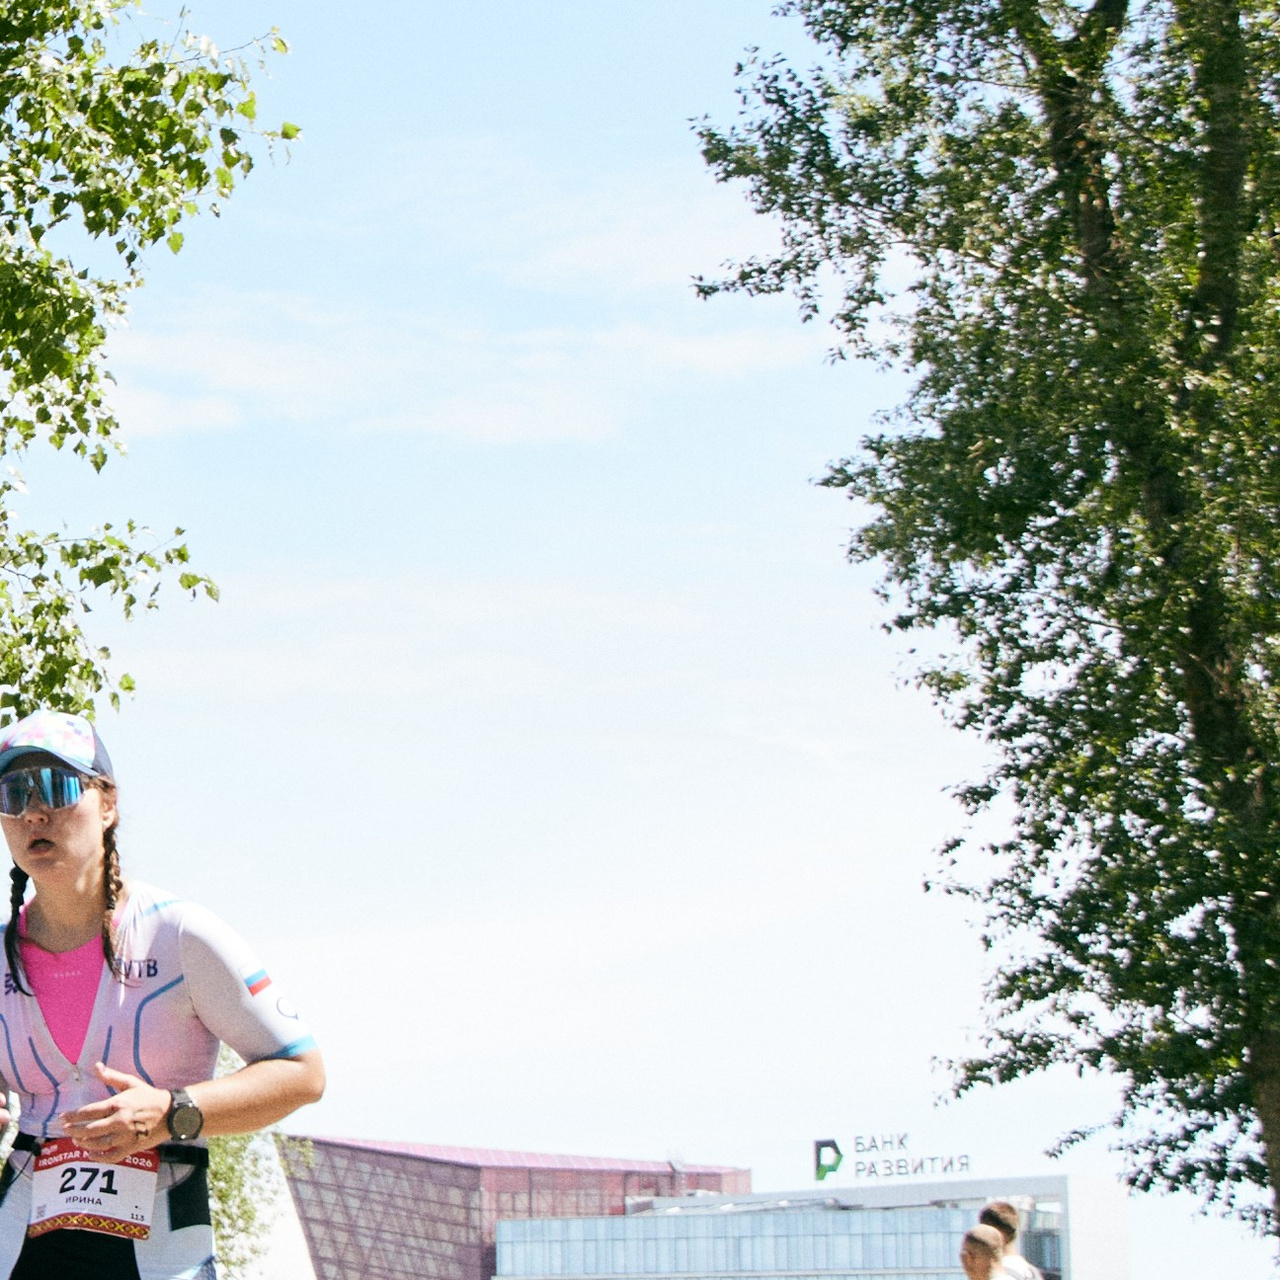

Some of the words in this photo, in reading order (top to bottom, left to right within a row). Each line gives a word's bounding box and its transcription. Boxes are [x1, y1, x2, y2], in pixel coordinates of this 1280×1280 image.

[123, 958, 158, 979] VTB
[854, 1132, 908, 1153] БАНК
[38, 1150, 80, 1167] IRONSTAR
[124, 1155, 153, 1168] 2026
[854, 1154, 970, 1178] РАЗВИТИЯ
[59, 1167, 118, 1195] 271
[65, 1195, 103, 1206] ИРИНА
